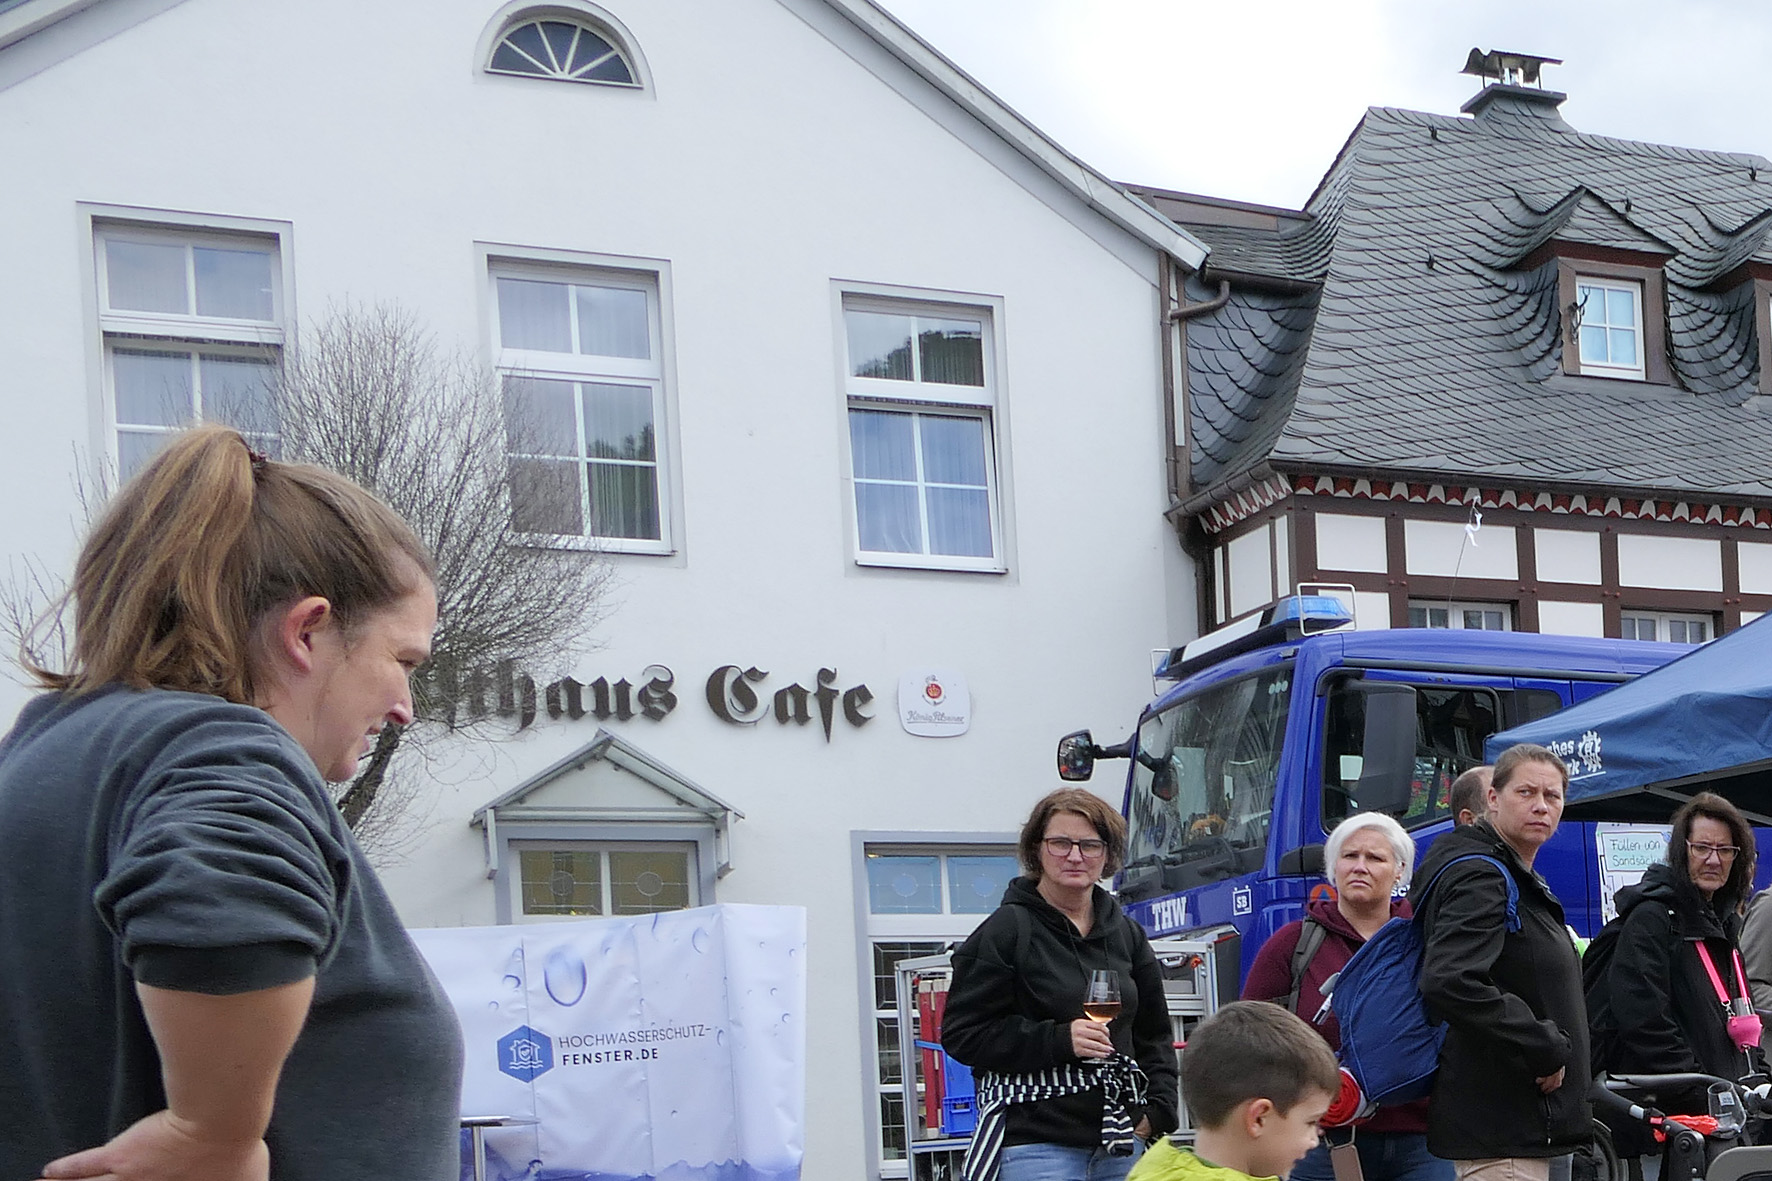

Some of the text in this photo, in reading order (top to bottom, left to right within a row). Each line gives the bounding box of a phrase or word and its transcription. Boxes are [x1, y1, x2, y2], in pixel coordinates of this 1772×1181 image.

[705, 664, 875, 744] Cafe
[1609, 838, 1661, 851] Füllen von
[1236, 895, 1248, 909] SB
[1151, 896, 1188, 932] THW
[559, 1024, 712, 1049] HOCHWASSERSCHUTZ-
[562, 1048, 659, 1066] FENSTER.DE
